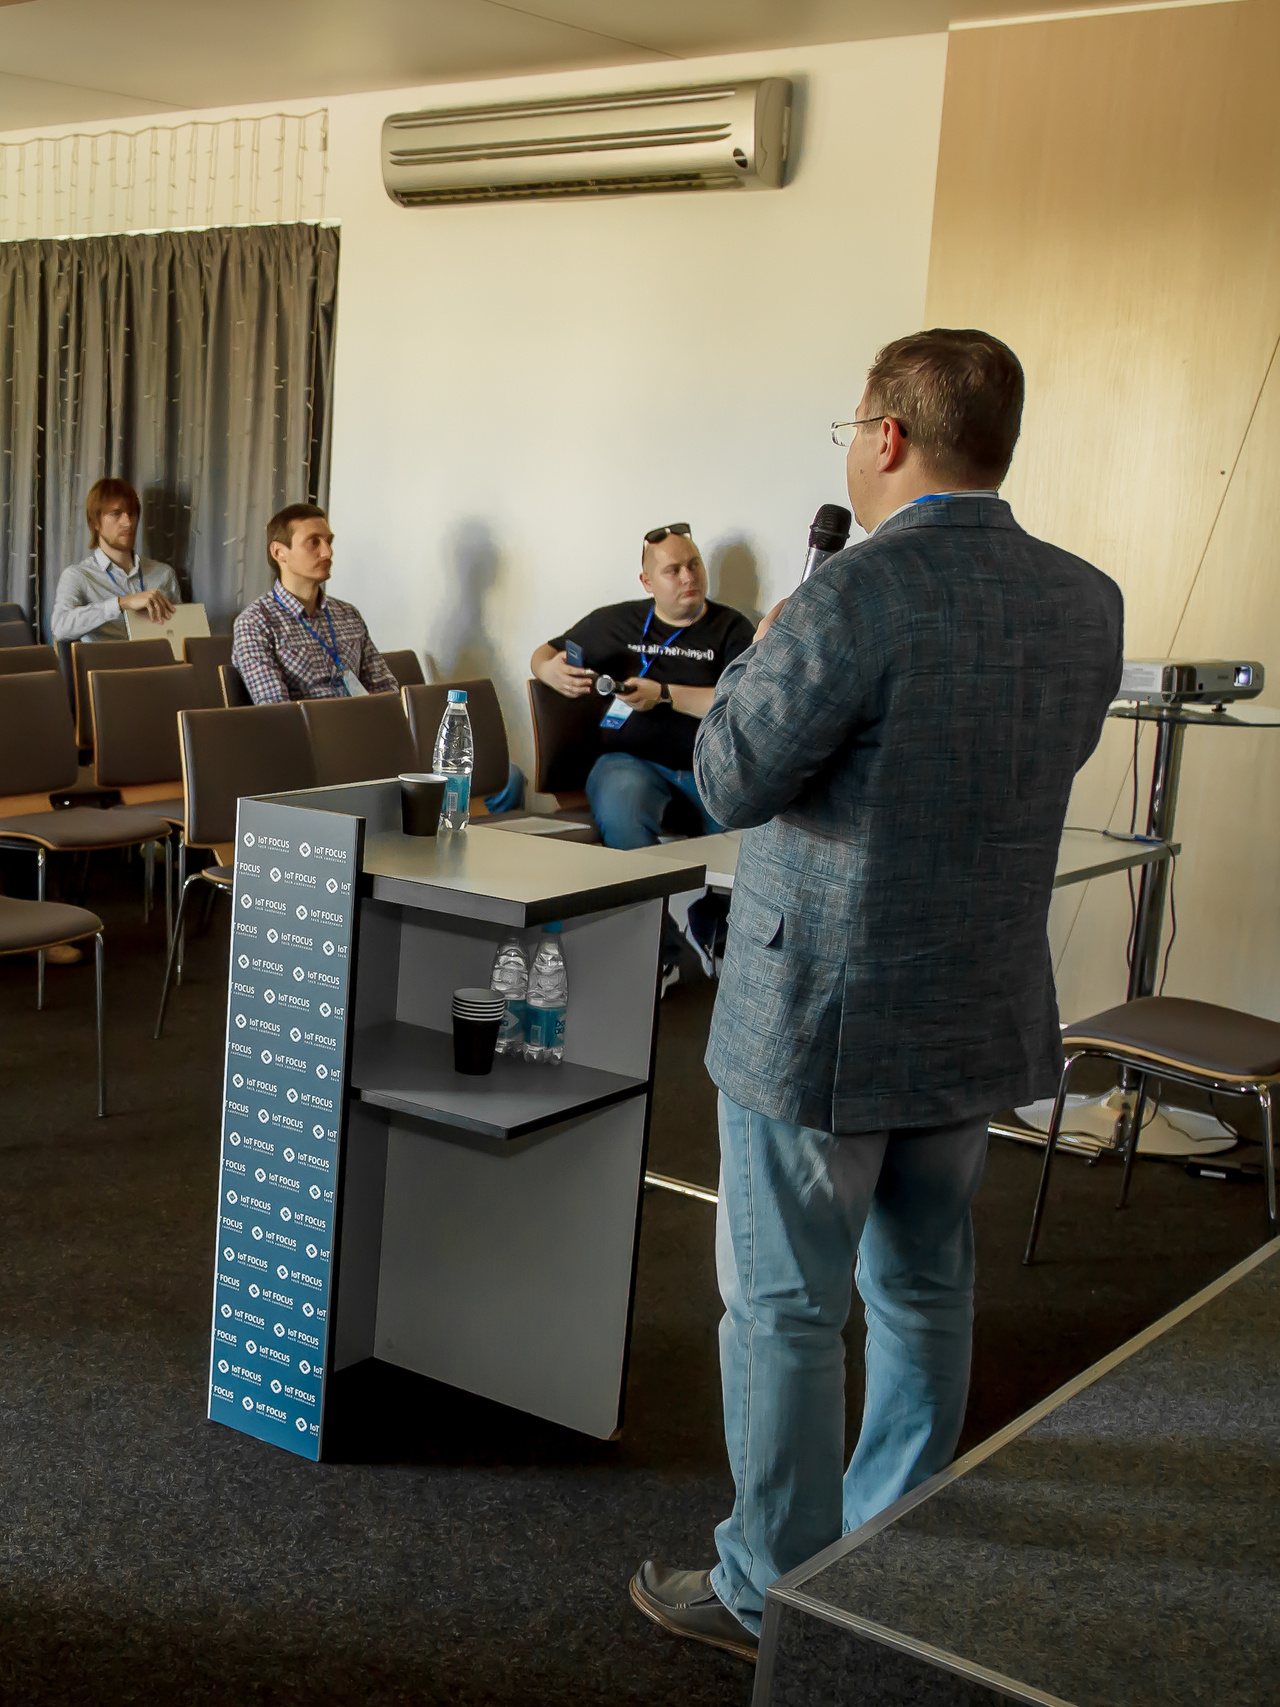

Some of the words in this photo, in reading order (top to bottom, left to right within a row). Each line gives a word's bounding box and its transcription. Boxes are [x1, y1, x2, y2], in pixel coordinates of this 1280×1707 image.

[258, 836, 268, 844] IoT
[269, 838, 290, 848] FOCUS
[314, 846, 324, 855] IoT
[325, 847, 347, 859] FOCUS
[240, 863, 260, 873] FOCUS
[284, 871, 294, 880] IoT
[295, 873, 316, 884] FOCUS
[341, 882, 351, 891] IoT
[255, 897, 264, 906] IoT
[265, 899, 286, 911] FOCUS
[311, 909, 321, 918] IoT
[321, 911, 344, 922] FOCUS
[237, 923, 258, 934] FOCUS
[281, 932, 291, 941] IoT
[292, 934, 313, 946] FOCUS
[338, 945, 348, 954] IoT
[252, 958, 262, 967] IoT
[262, 960, 283, 971] FOCUS
[307, 971, 317, 980] IoT
[318, 973, 340, 985] FOCUS
[234, 983, 255, 994] FOCUS
[278, 993, 288, 1002] IoT
[289, 995, 310, 1007] FOCUS
[334, 1006, 344, 1016] IoT
[249, 1018, 259, 1027] IoT
[259, 1020, 280, 1032] FOCUS
[304, 1031, 314, 1040] IoT
[315, 1034, 337, 1046] FOCUS
[231, 1043, 252, 1055] FOCUS
[275, 1054, 285, 1063] IoT
[286, 1056, 307, 1069] FOCUS
[331, 1068, 341, 1078] IoT
[247, 1078, 256, 1087] IoT
[257, 1080, 277, 1092] FOCUS
[301, 1093, 311, 1102] IoT
[312, 1096, 333, 1108] FOCUS
[229, 1101, 249, 1114] FOCUS
[272, 1113, 282, 1123] IoT
[282, 1116, 303, 1129] FOCUS
[327, 1129, 337, 1139] IoT
[244, 1136, 253, 1145] IoT
[254, 1139, 274, 1151] FOCUS
[226, 1160, 246, 1172] FOCUS
[298, 1152, 307, 1162] IoT
[308, 1155, 329, 1168] FOCUS
[269, 1172, 279, 1182] IoT
[279, 1175, 300, 1188] FOCUS
[324, 1189, 334, 1199] IoT
[240, 1194, 250, 1204] IoT
[250, 1198, 271, 1210] FOCUS
[223, 1217, 243, 1230] FOCUS
[294, 1211, 304, 1221] IoT
[305, 1215, 326, 1228] FOCUS
[266, 1231, 275, 1240] IoT
[276, 1234, 297, 1247] FOCUS
[237, 1252, 247, 1261] IoT
[247, 1255, 267, 1268] FOCUS
[320, 1249, 330, 1258] IoT
[220, 1274, 240, 1287] FOCUS
[291, 1270, 301, 1280] IoT
[301, 1273, 323, 1287] FOCUS
[263, 1289, 272, 1298] IoT
[273, 1292, 293, 1306] FOCUS
[234, 1309, 244, 1318] IoT
[244, 1312, 264, 1326] FOCUS
[317, 1308, 327, 1318] IoT
[217, 1330, 237, 1343] FOCUS
[288, 1328, 297, 1338] IoT
[298, 1332, 319, 1346] FOCUS
[259, 1345, 269, 1355] IoT
[270, 1349, 290, 1363] FOCUS
[232, 1364, 241, 1374] IoT
[241, 1368, 261, 1382] FOCUS
[313, 1365, 323, 1375] IoT
[214, 1386, 234, 1399] FOCUS
[285, 1385, 294, 1395] IoT
[295, 1389, 316, 1403] FOCUS
[256, 1402, 265, 1412] IoT
[266, 1406, 286, 1420] FOCUS
[310, 1423, 320, 1433] IoT
